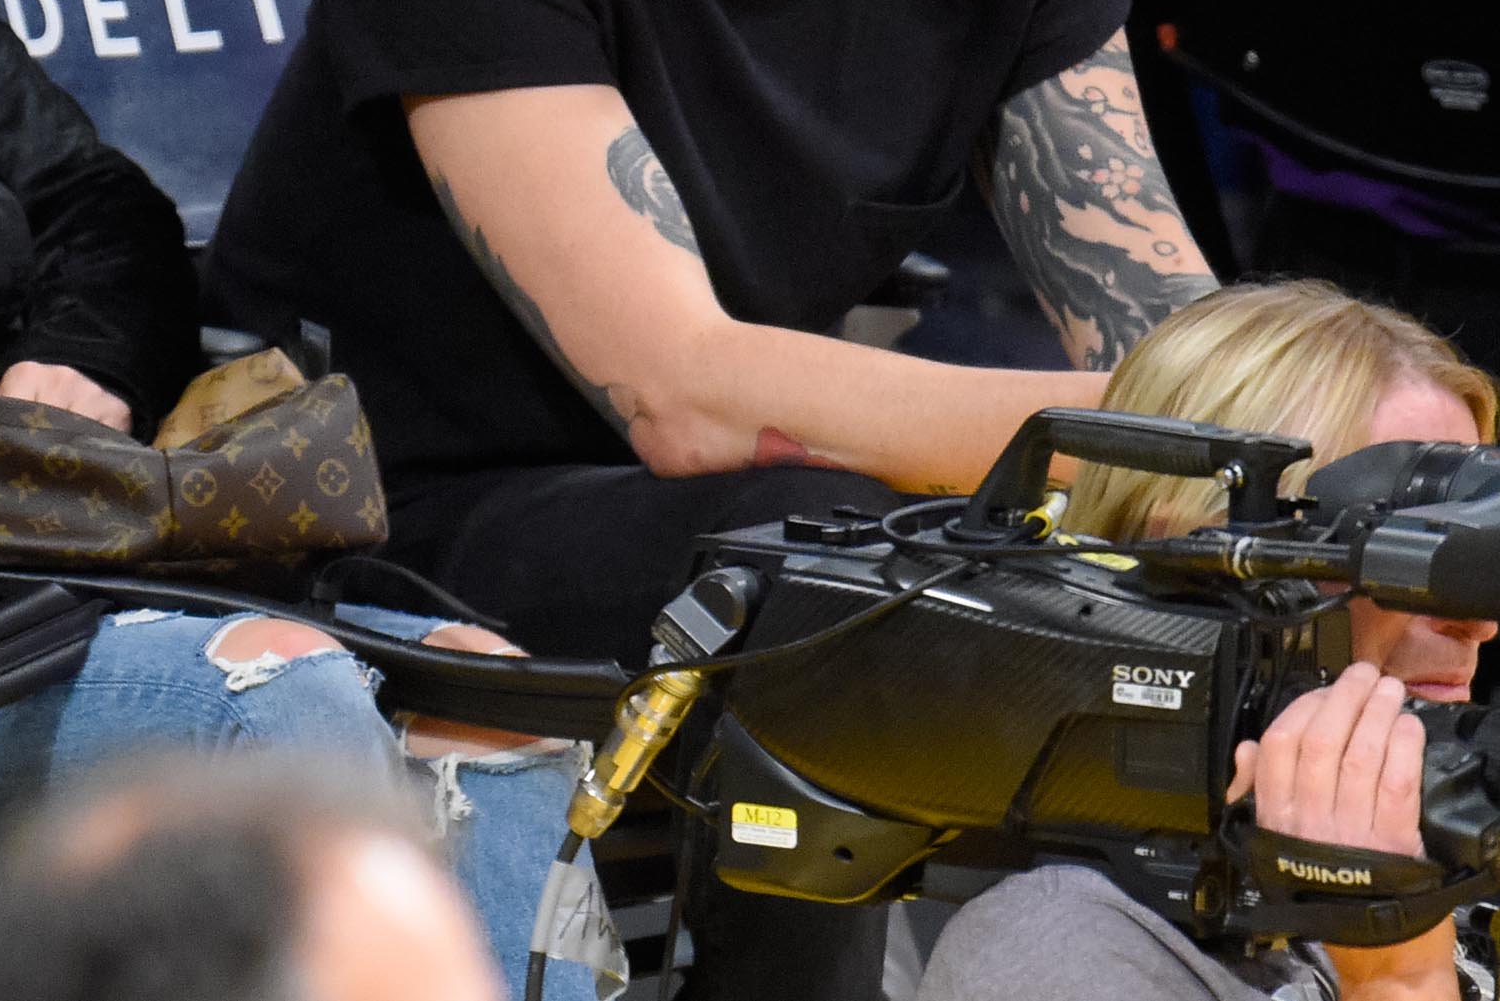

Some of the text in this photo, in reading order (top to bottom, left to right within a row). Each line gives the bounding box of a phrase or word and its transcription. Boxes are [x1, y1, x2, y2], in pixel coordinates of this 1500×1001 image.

[1112, 664, 1195, 688] SONY
[744, 807, 782, 826] M-12
[1277, 857, 1372, 885] FUJINON
